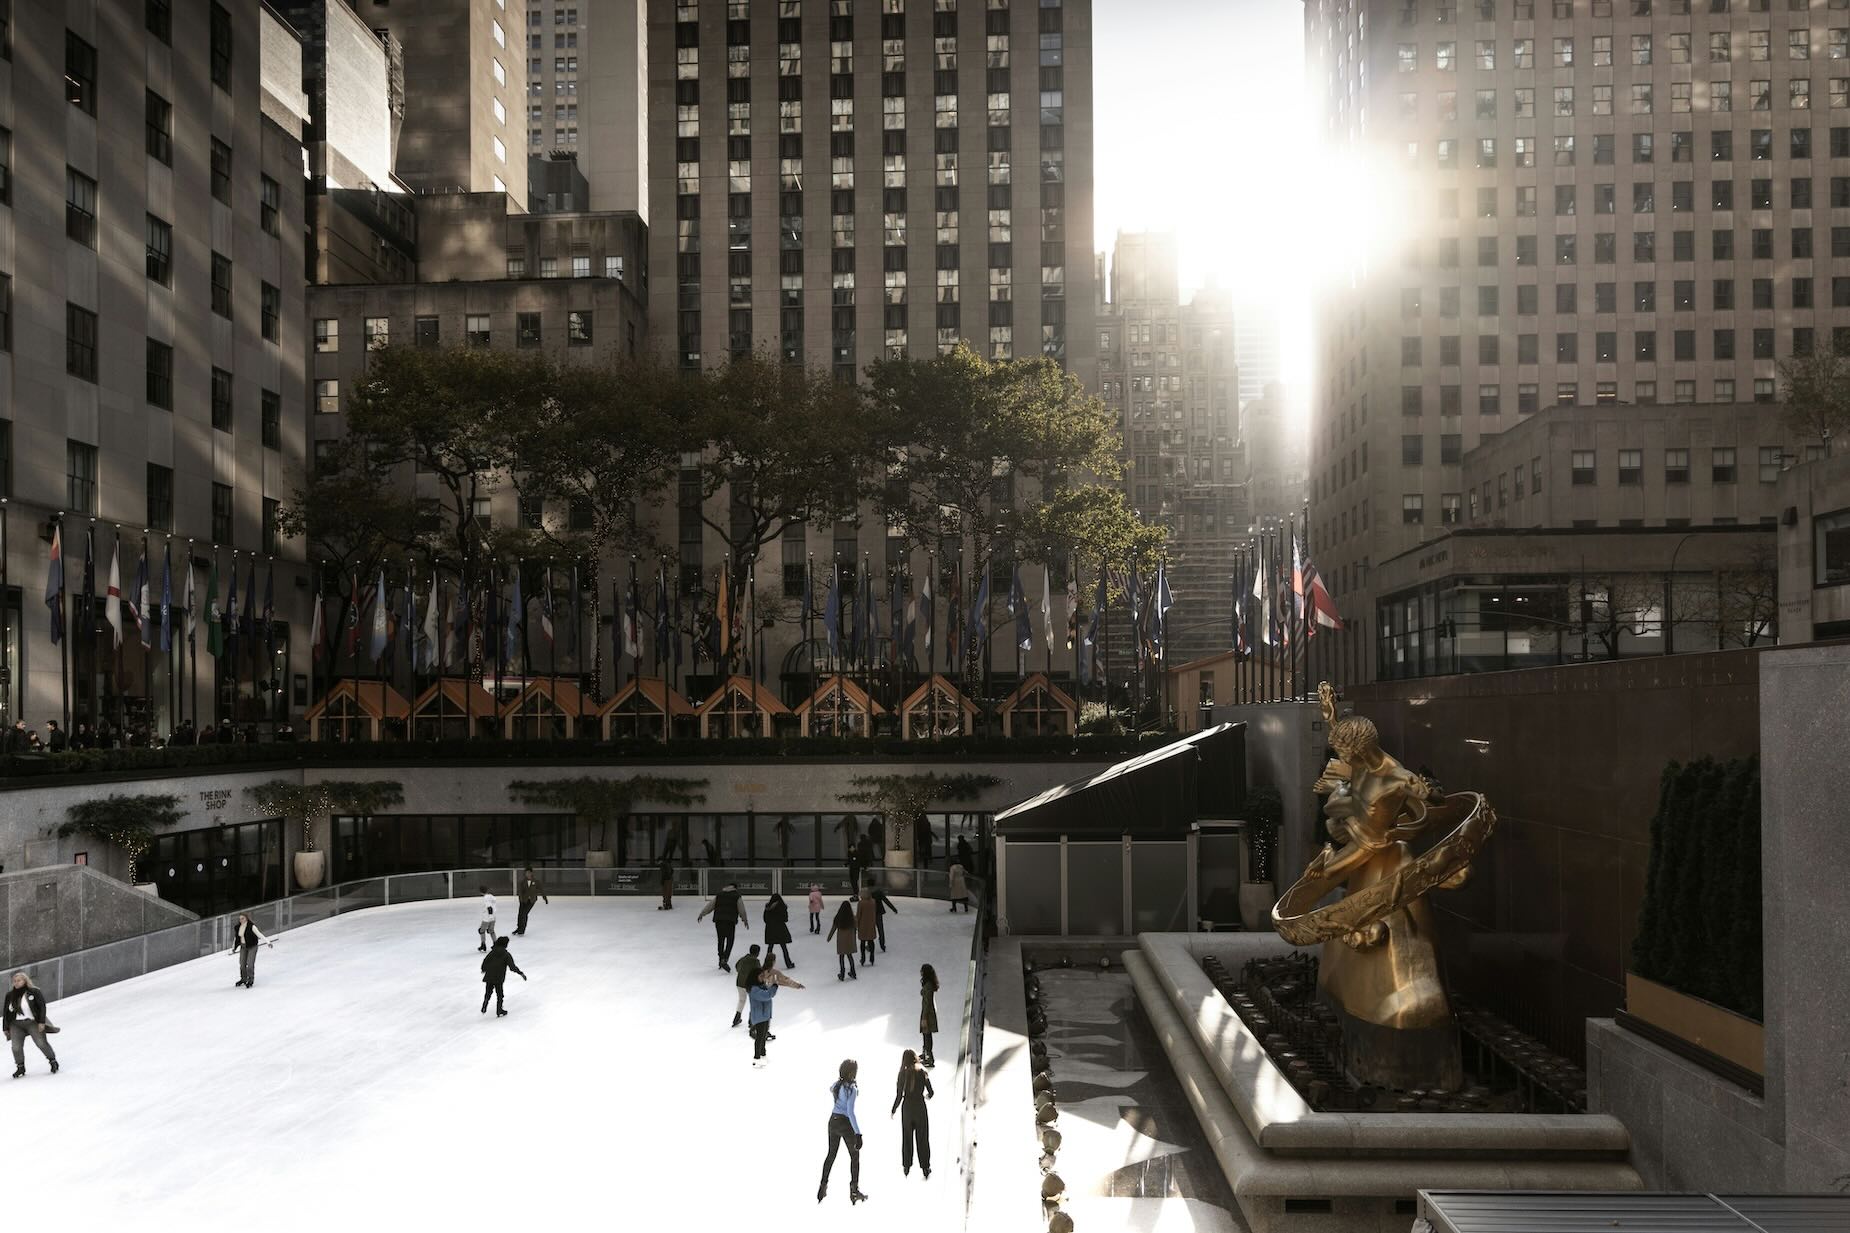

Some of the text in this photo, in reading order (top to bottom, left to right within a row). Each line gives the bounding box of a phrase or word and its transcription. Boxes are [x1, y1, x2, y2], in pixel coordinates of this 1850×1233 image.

[200, 789, 231, 801] THE RINK
[206, 800, 226, 810] SHOP
